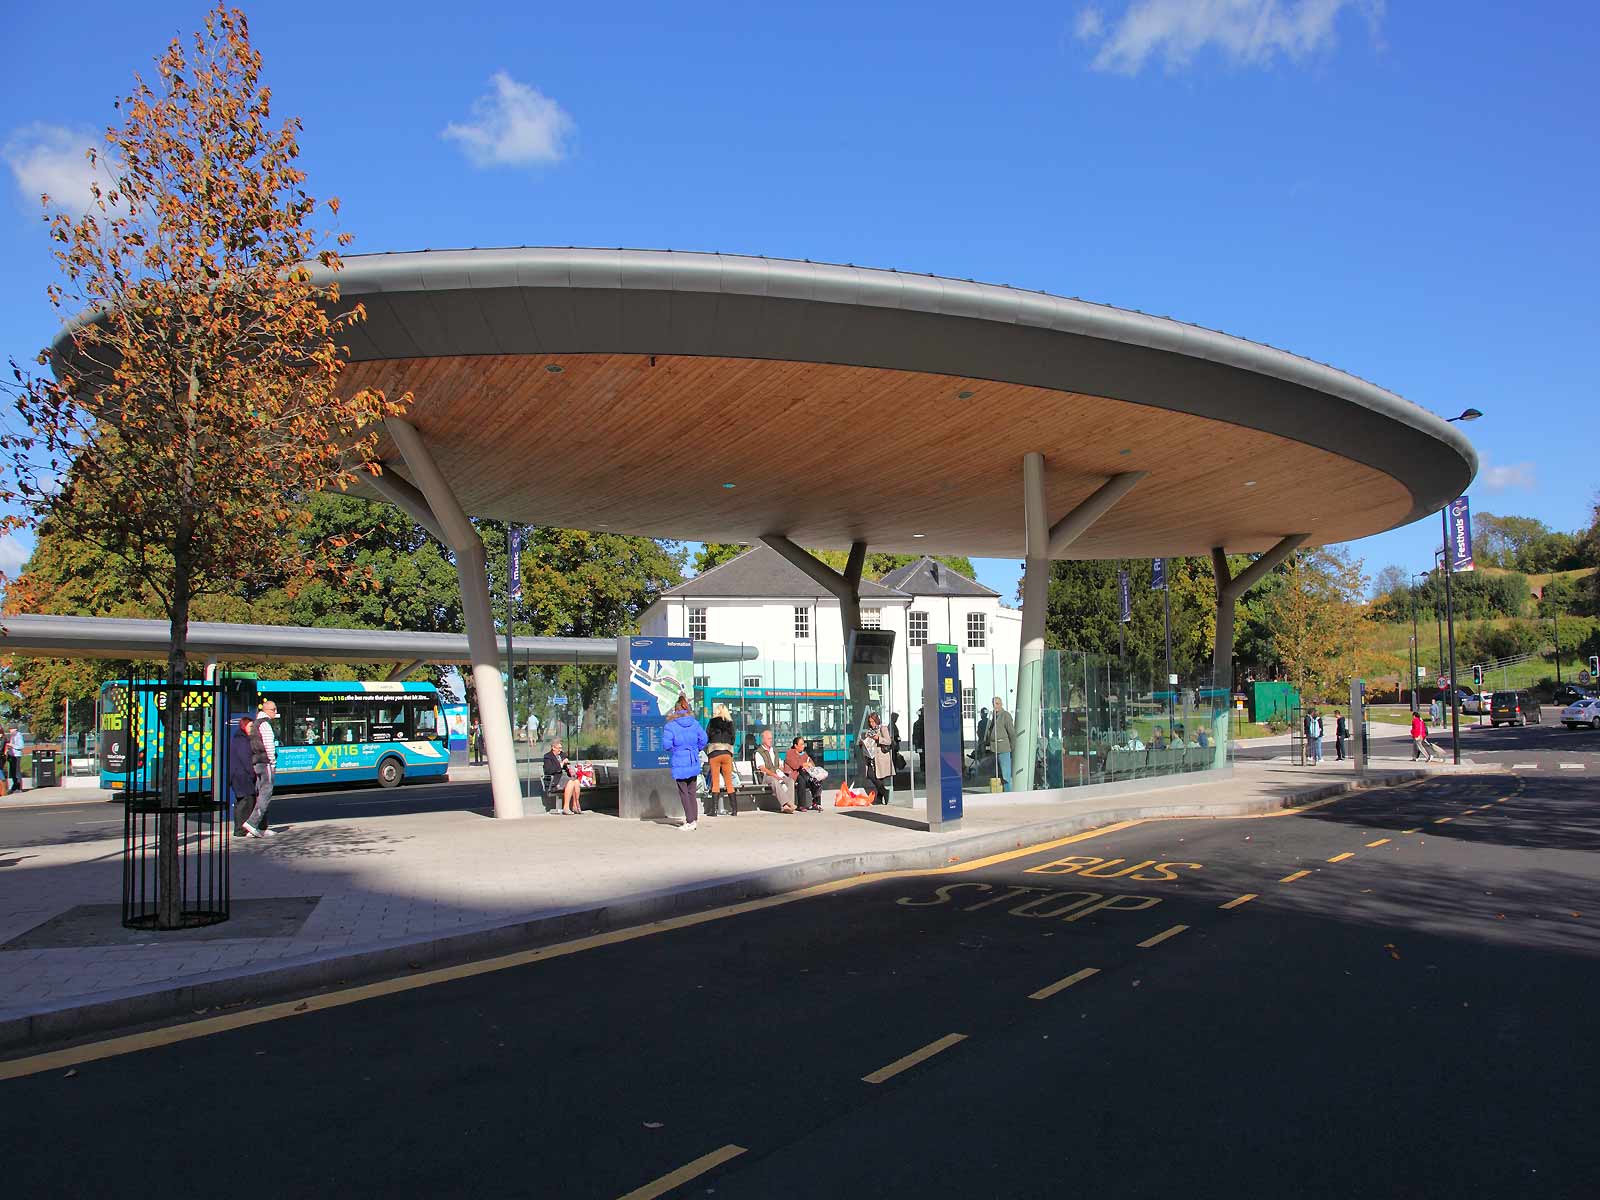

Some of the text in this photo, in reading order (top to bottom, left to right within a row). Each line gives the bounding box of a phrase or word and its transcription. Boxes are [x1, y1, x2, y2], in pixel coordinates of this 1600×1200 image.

[1456, 518, 1466, 558] Festivals
[945, 653, 951, 668] 2
[234, 680, 242, 691] 7
[1023, 856, 1203, 881] BUS
[896, 883, 1163, 922] STOP
